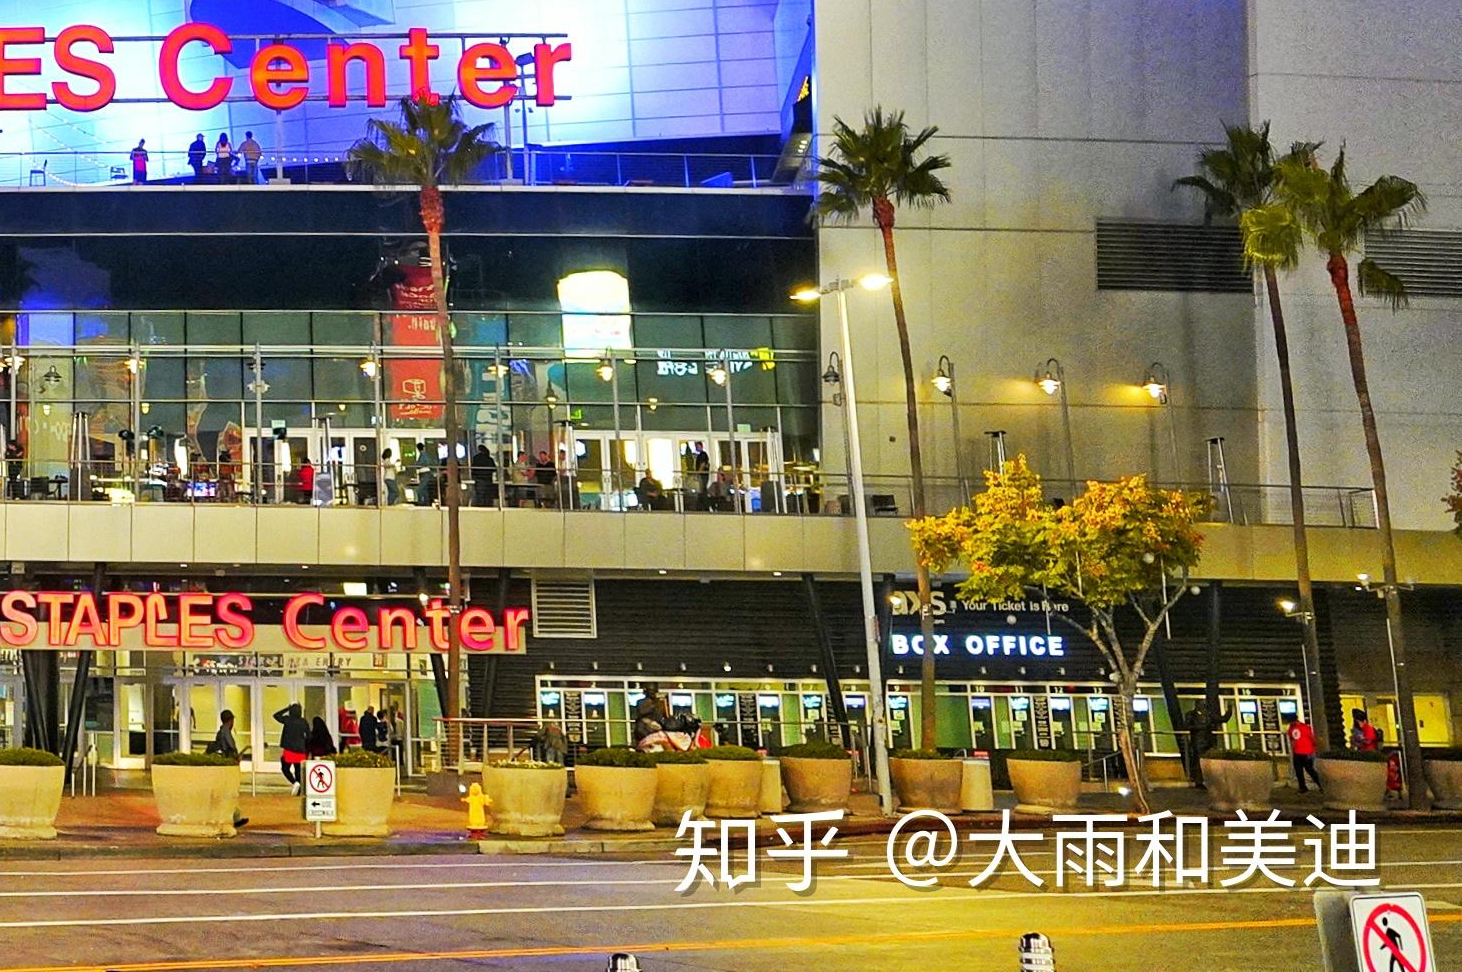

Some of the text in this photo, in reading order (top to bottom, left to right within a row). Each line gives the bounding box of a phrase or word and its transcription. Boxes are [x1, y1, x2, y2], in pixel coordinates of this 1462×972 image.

[158, 22, 572, 111] Center
[0, 590, 529, 650] STAPLES Center
[962, 600, 988, 611] Your
[992, 600, 1027, 612] Ticket
[1029, 601, 1041, 612] Is
[891, 634, 1064, 656] BOX OFFICE
